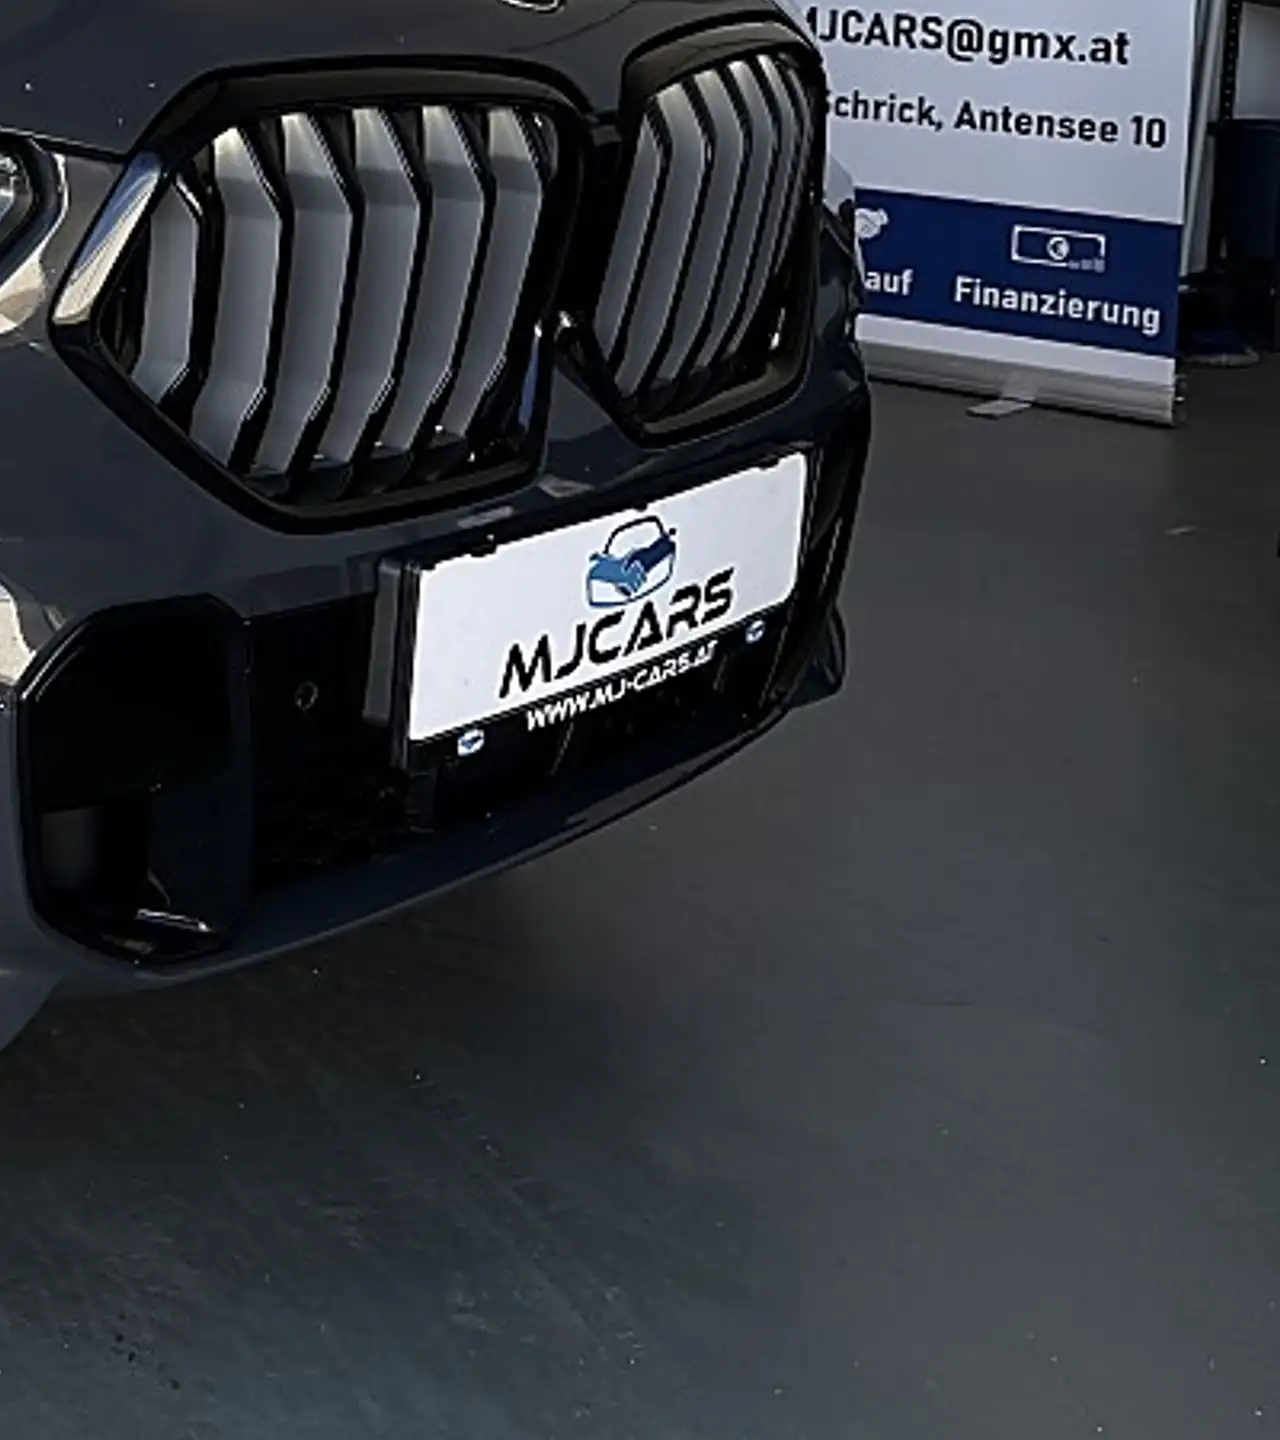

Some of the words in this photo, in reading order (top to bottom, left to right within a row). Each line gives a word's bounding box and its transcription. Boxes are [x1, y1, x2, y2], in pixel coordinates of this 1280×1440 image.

[824, 89, 943, 132] chrick,
[953, 100, 1119, 143] Antensee
[1129, 115, 1167, 149] 10
[953, 275, 1161, 337] Finanzierung
[498, 567, 735, 699] MJCARS
